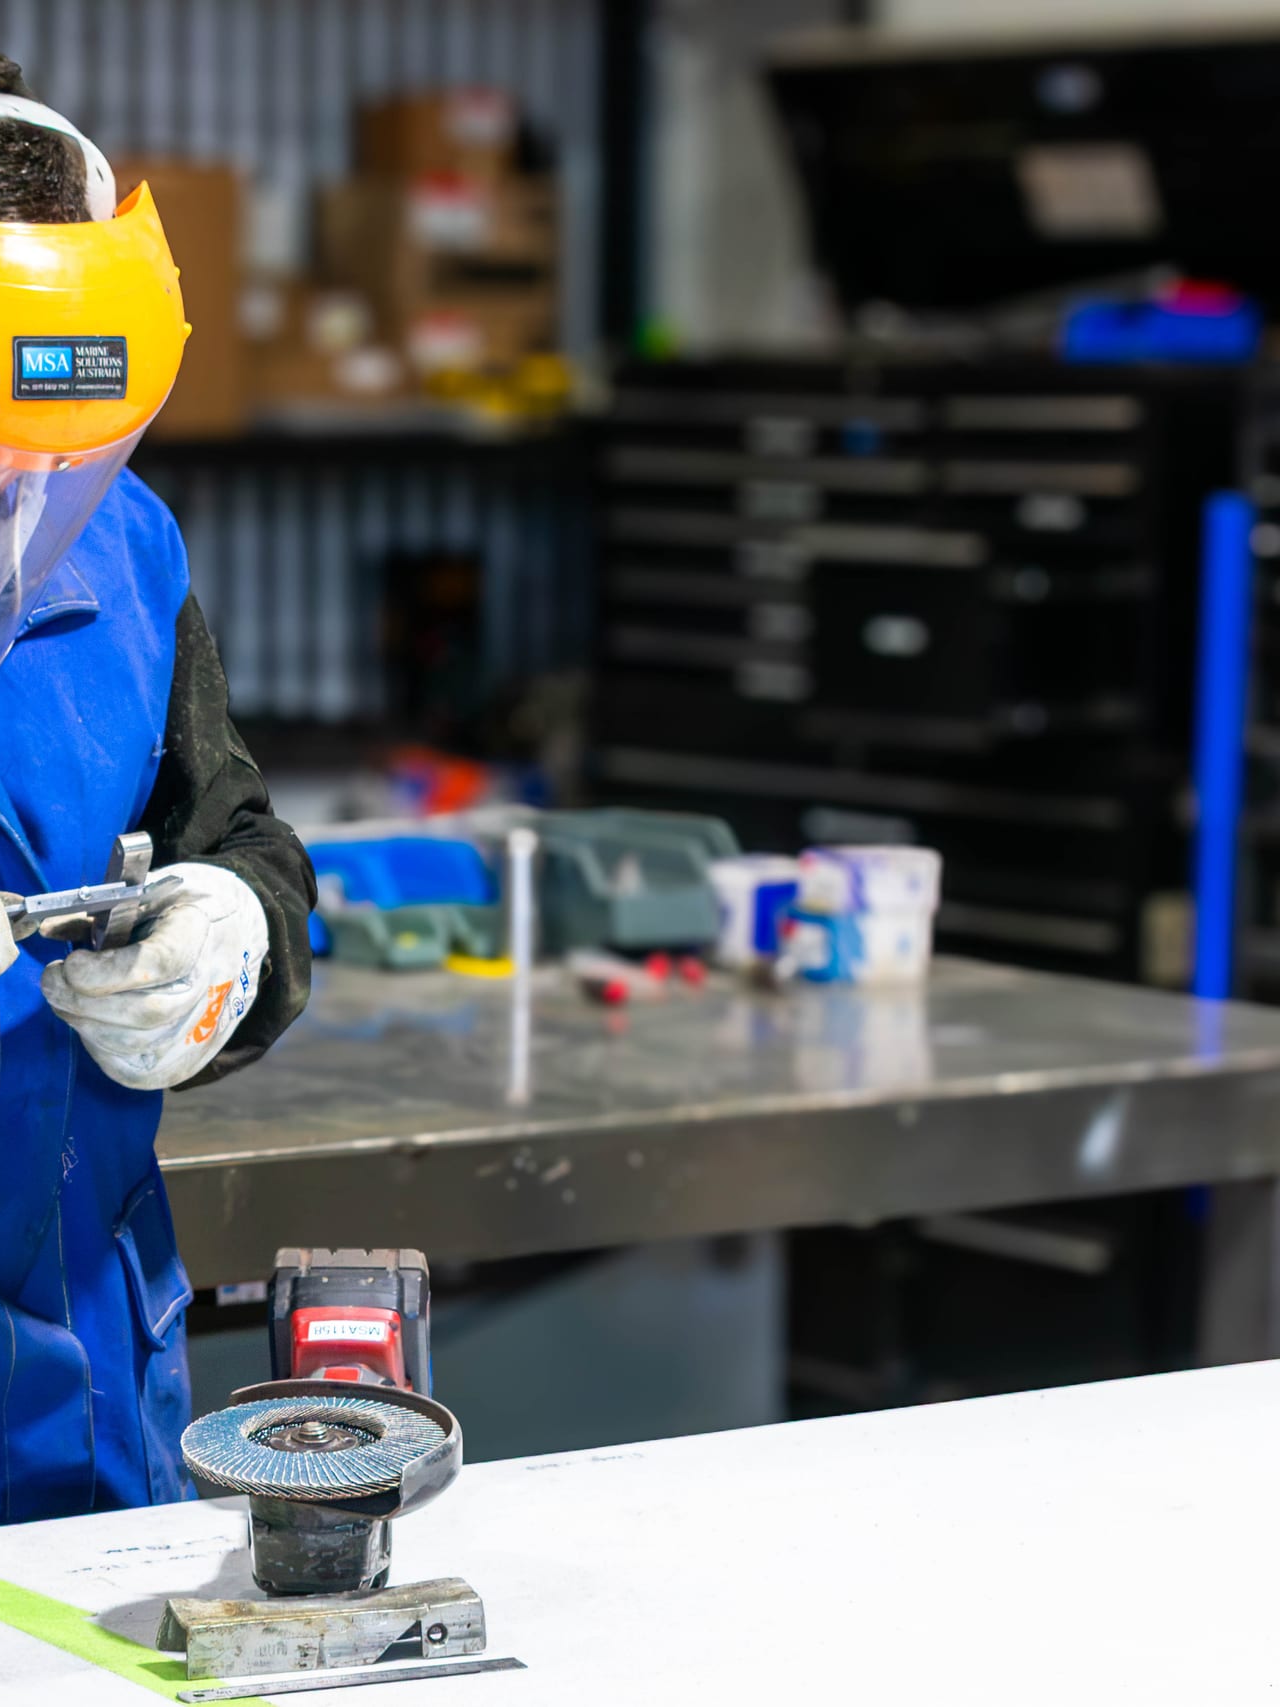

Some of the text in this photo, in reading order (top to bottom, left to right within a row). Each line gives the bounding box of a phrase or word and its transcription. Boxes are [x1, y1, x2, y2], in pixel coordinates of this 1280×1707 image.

[75, 346, 109, 357] MARINE
[25, 352, 70, 373] MSA
[75, 357, 123, 368] SOLUTIONS
[76, 368, 121, 379] AUSTRALIA
